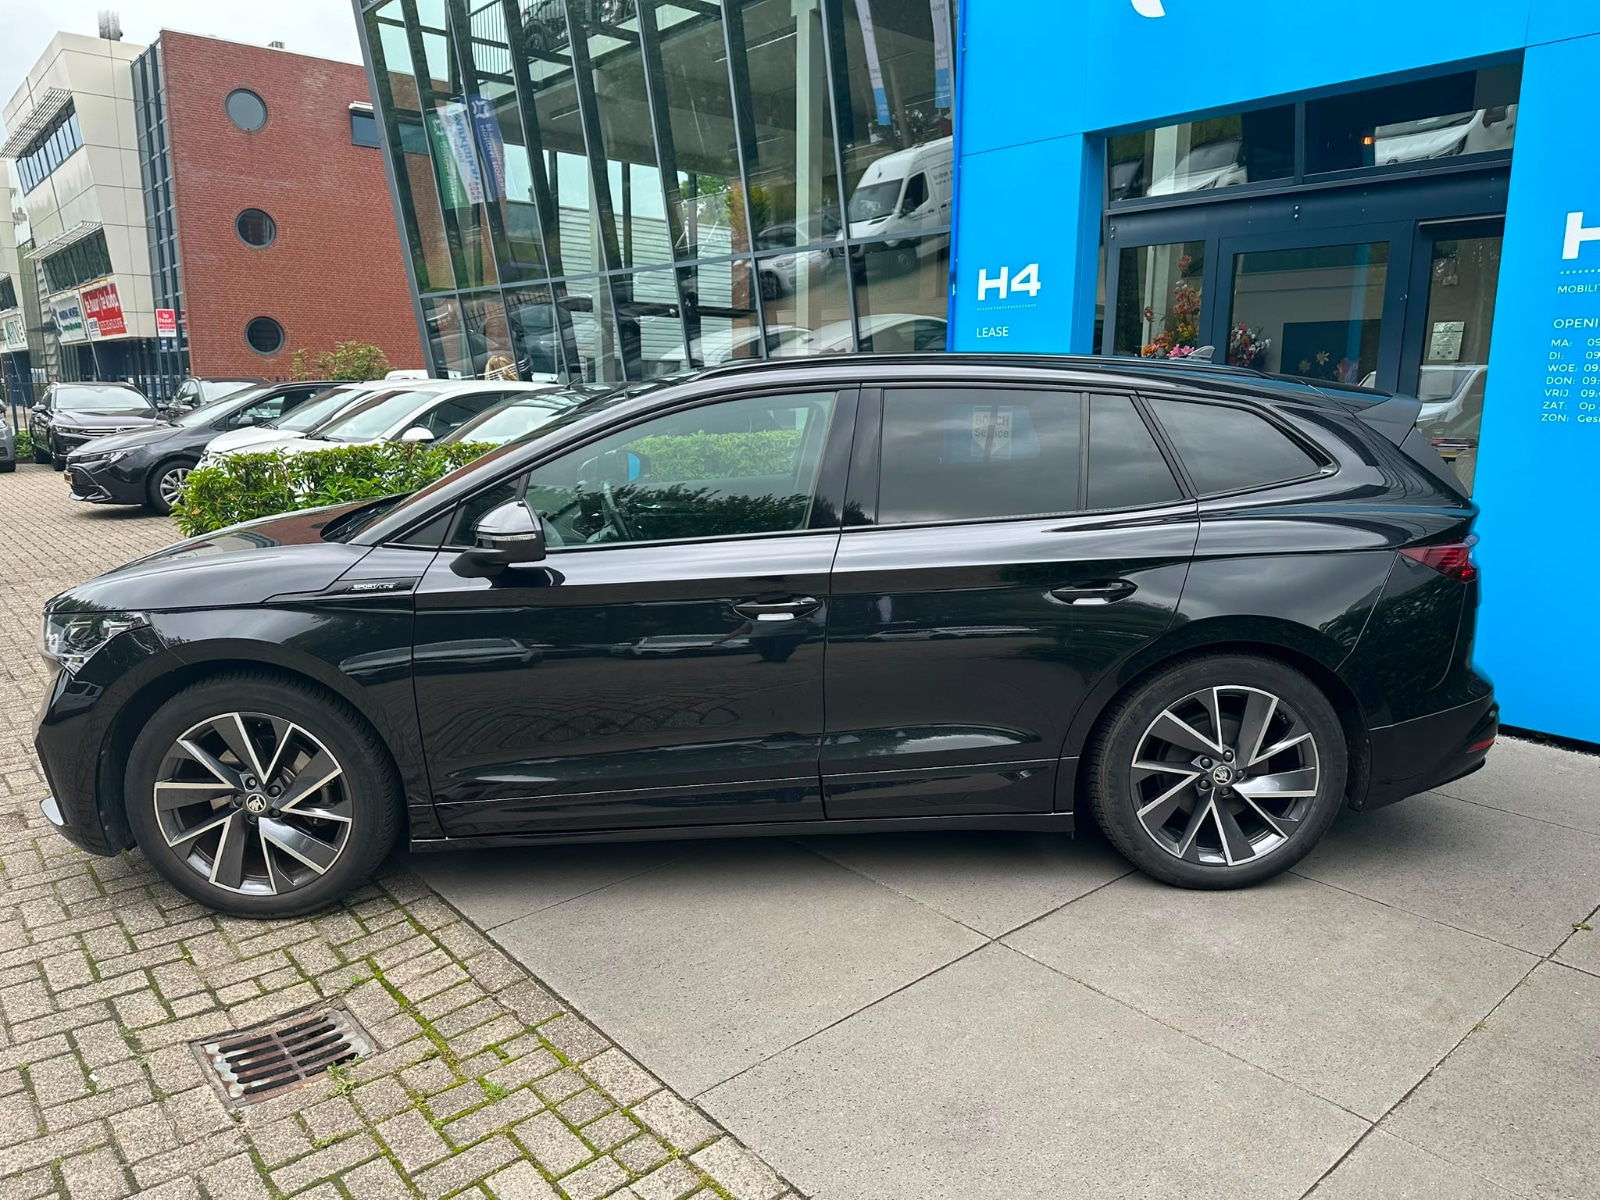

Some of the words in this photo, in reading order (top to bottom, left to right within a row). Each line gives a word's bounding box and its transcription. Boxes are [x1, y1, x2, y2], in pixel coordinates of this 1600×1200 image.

[977, 263, 1041, 301] H4
[1557, 283, 1600, 293] MOBILI
[1553, 317, 1599, 329] OPENI
[976, 326, 1009, 338] LEASE
[1549, 351, 1563, 359] DI:
[1548, 363, 1577, 372] WOE:
[1546, 376, 1575, 385] DON:
[1579, 401, 1596, 412] Op
[975, 415, 1010, 426] BOCH
[1541, 413, 1569, 422] ZON:
[974, 428, 1009, 438] Seice
